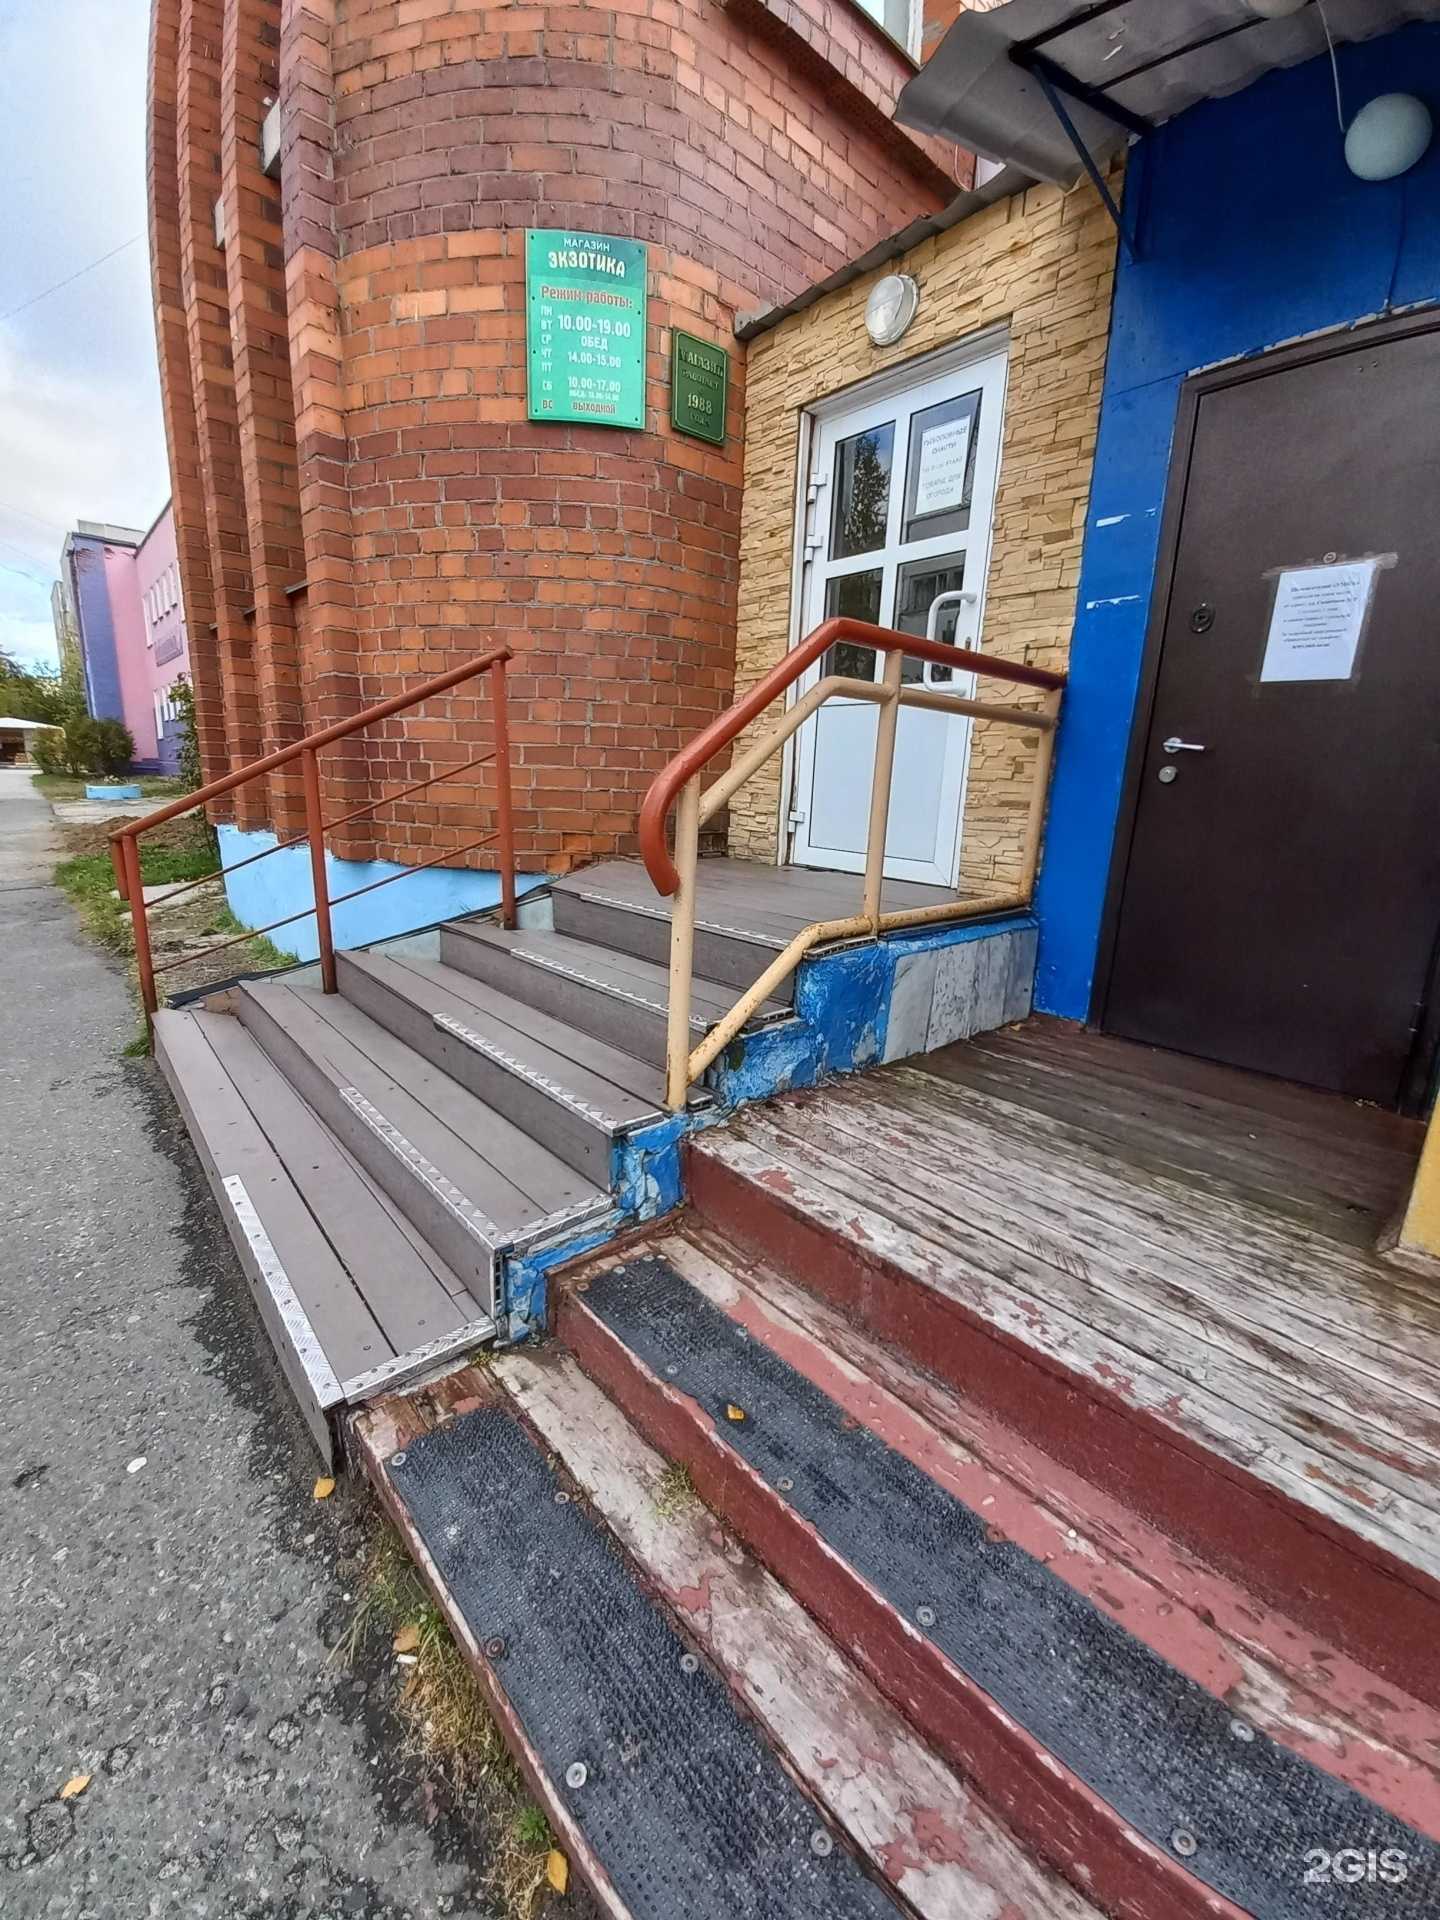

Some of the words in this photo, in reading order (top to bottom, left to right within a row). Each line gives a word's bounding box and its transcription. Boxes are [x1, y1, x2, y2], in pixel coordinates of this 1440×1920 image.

[563, 238, 610, 252] МАГАЗИН
[548, 251, 626, 278] ЭКЗОТИКА
[541, 285, 582, 301] Режим
[586, 291, 633, 309] работы:
[558, 314, 631, 338] 10.00-19.00
[581, 336, 608, 351] ОБЕД
[568, 351, 621, 368] 14.00-15.00
[568, 376, 621, 393] 10.00-17.00
[543, 400, 552, 409] ВС
[573, 402, 616, 414] ВЫХОДНОЙ
[688, 392, 712, 414] 1988
